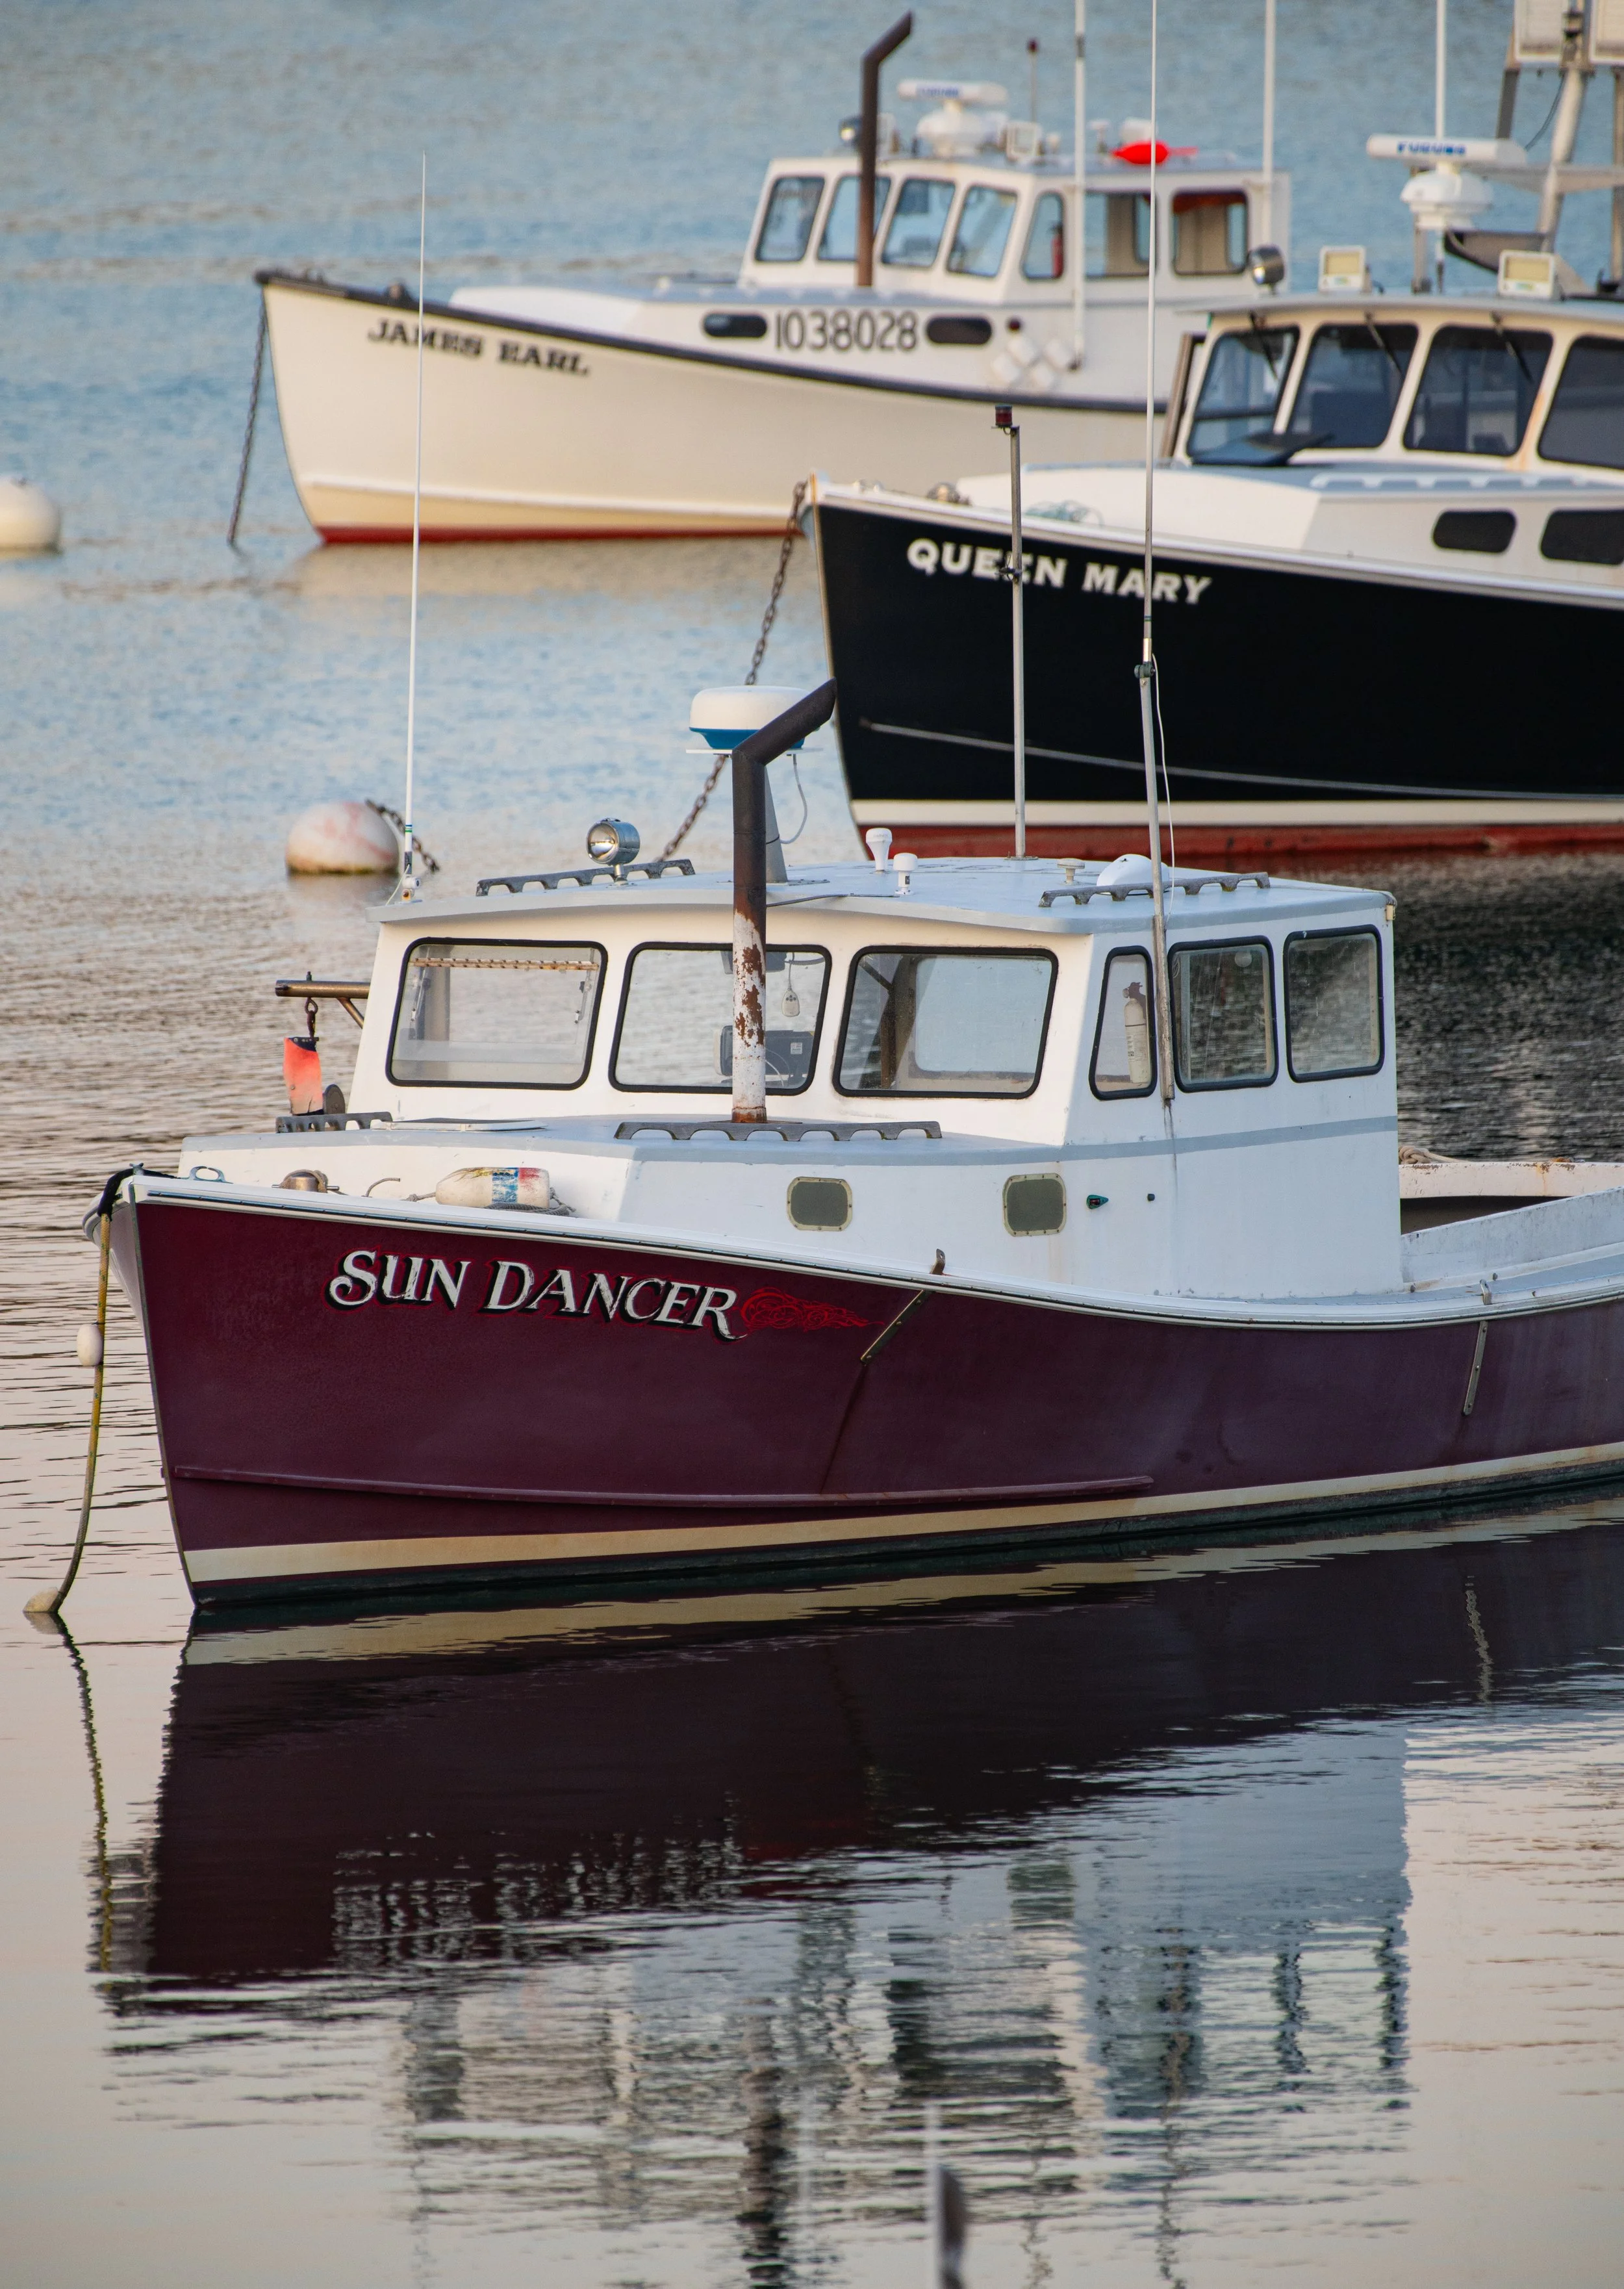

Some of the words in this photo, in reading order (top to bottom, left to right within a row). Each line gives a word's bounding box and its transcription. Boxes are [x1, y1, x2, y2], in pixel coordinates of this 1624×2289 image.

[367, 318, 483, 358] JAMES
[498, 340, 590, 376] EARL
[774, 309, 918, 352] 1038028
[1081, 561, 1213, 605] MARY
[325, 1250, 472, 1311] SUN
[479, 1260, 748, 1342] DANCER
